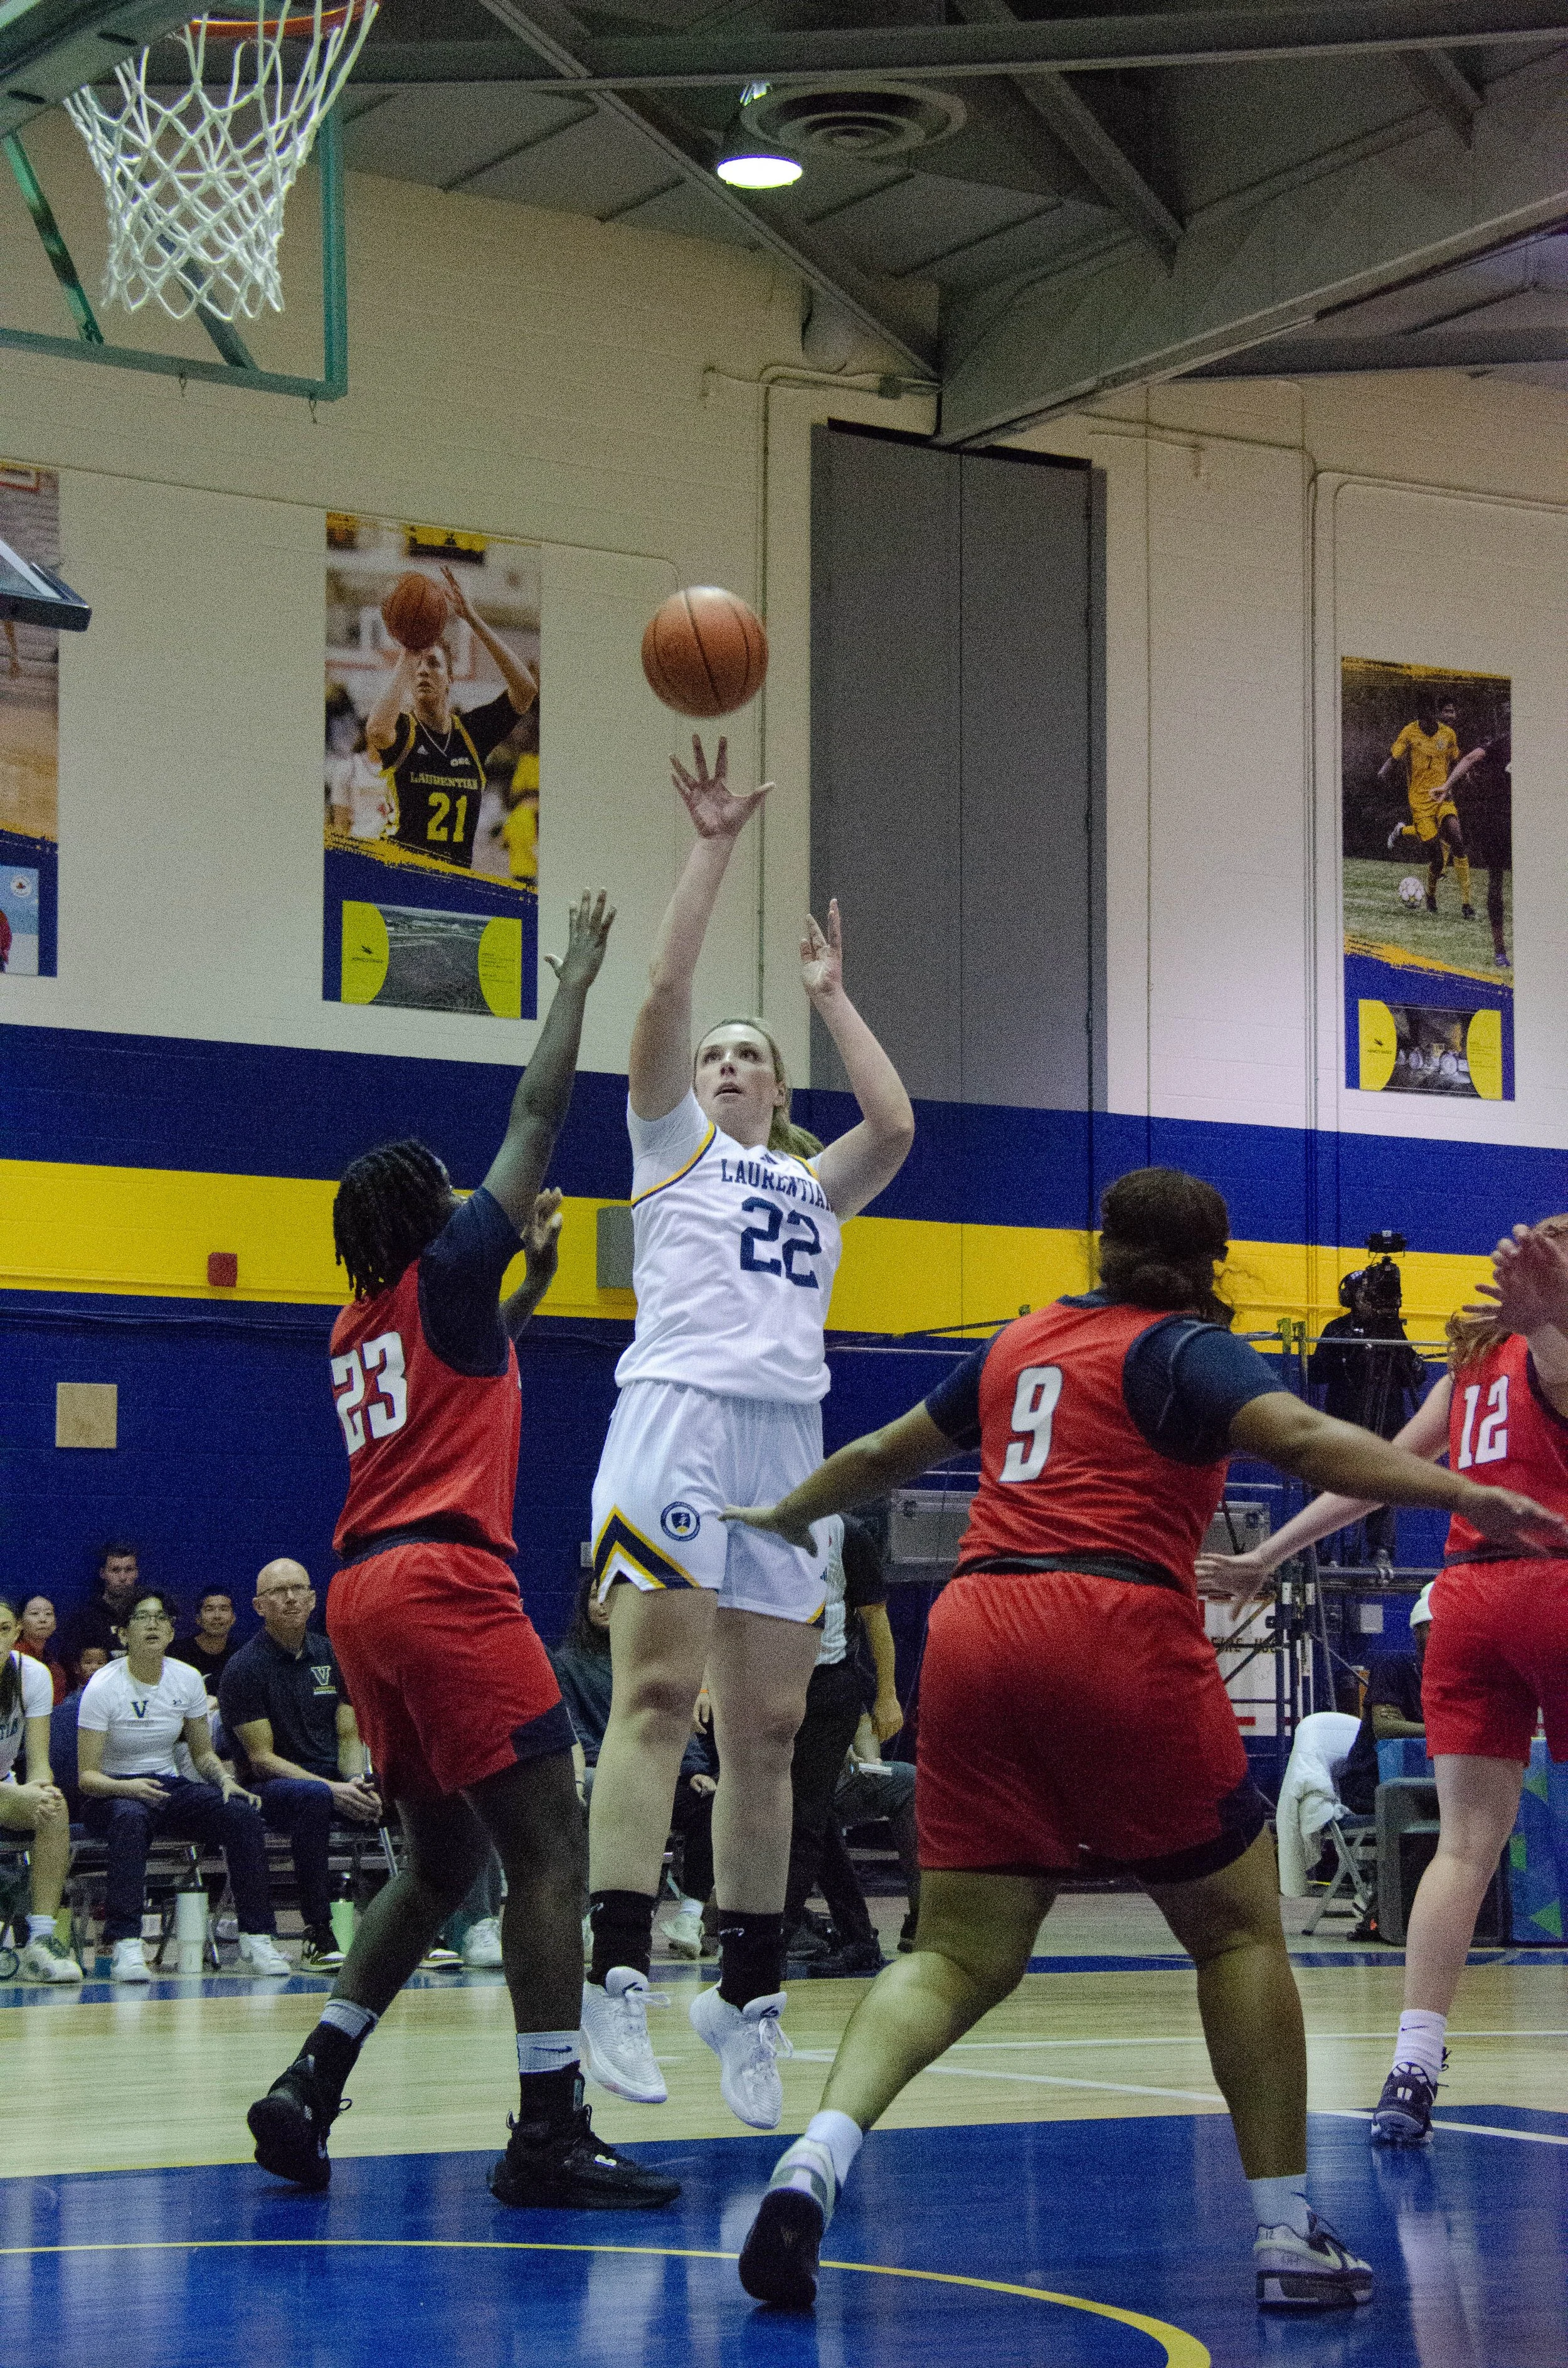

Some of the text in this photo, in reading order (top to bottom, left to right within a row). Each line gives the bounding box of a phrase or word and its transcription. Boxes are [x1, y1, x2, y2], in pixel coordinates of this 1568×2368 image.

[427, 792, 467, 842] 21
[721, 1159, 831, 1212] LAURENTIA
[739, 1196, 822, 1290] 22
[331, 1331, 408, 1456] 23
[999, 1365, 1063, 1483] 9
[1458, 1374, 1509, 1470] 12
[130, 1700, 149, 1719] V
